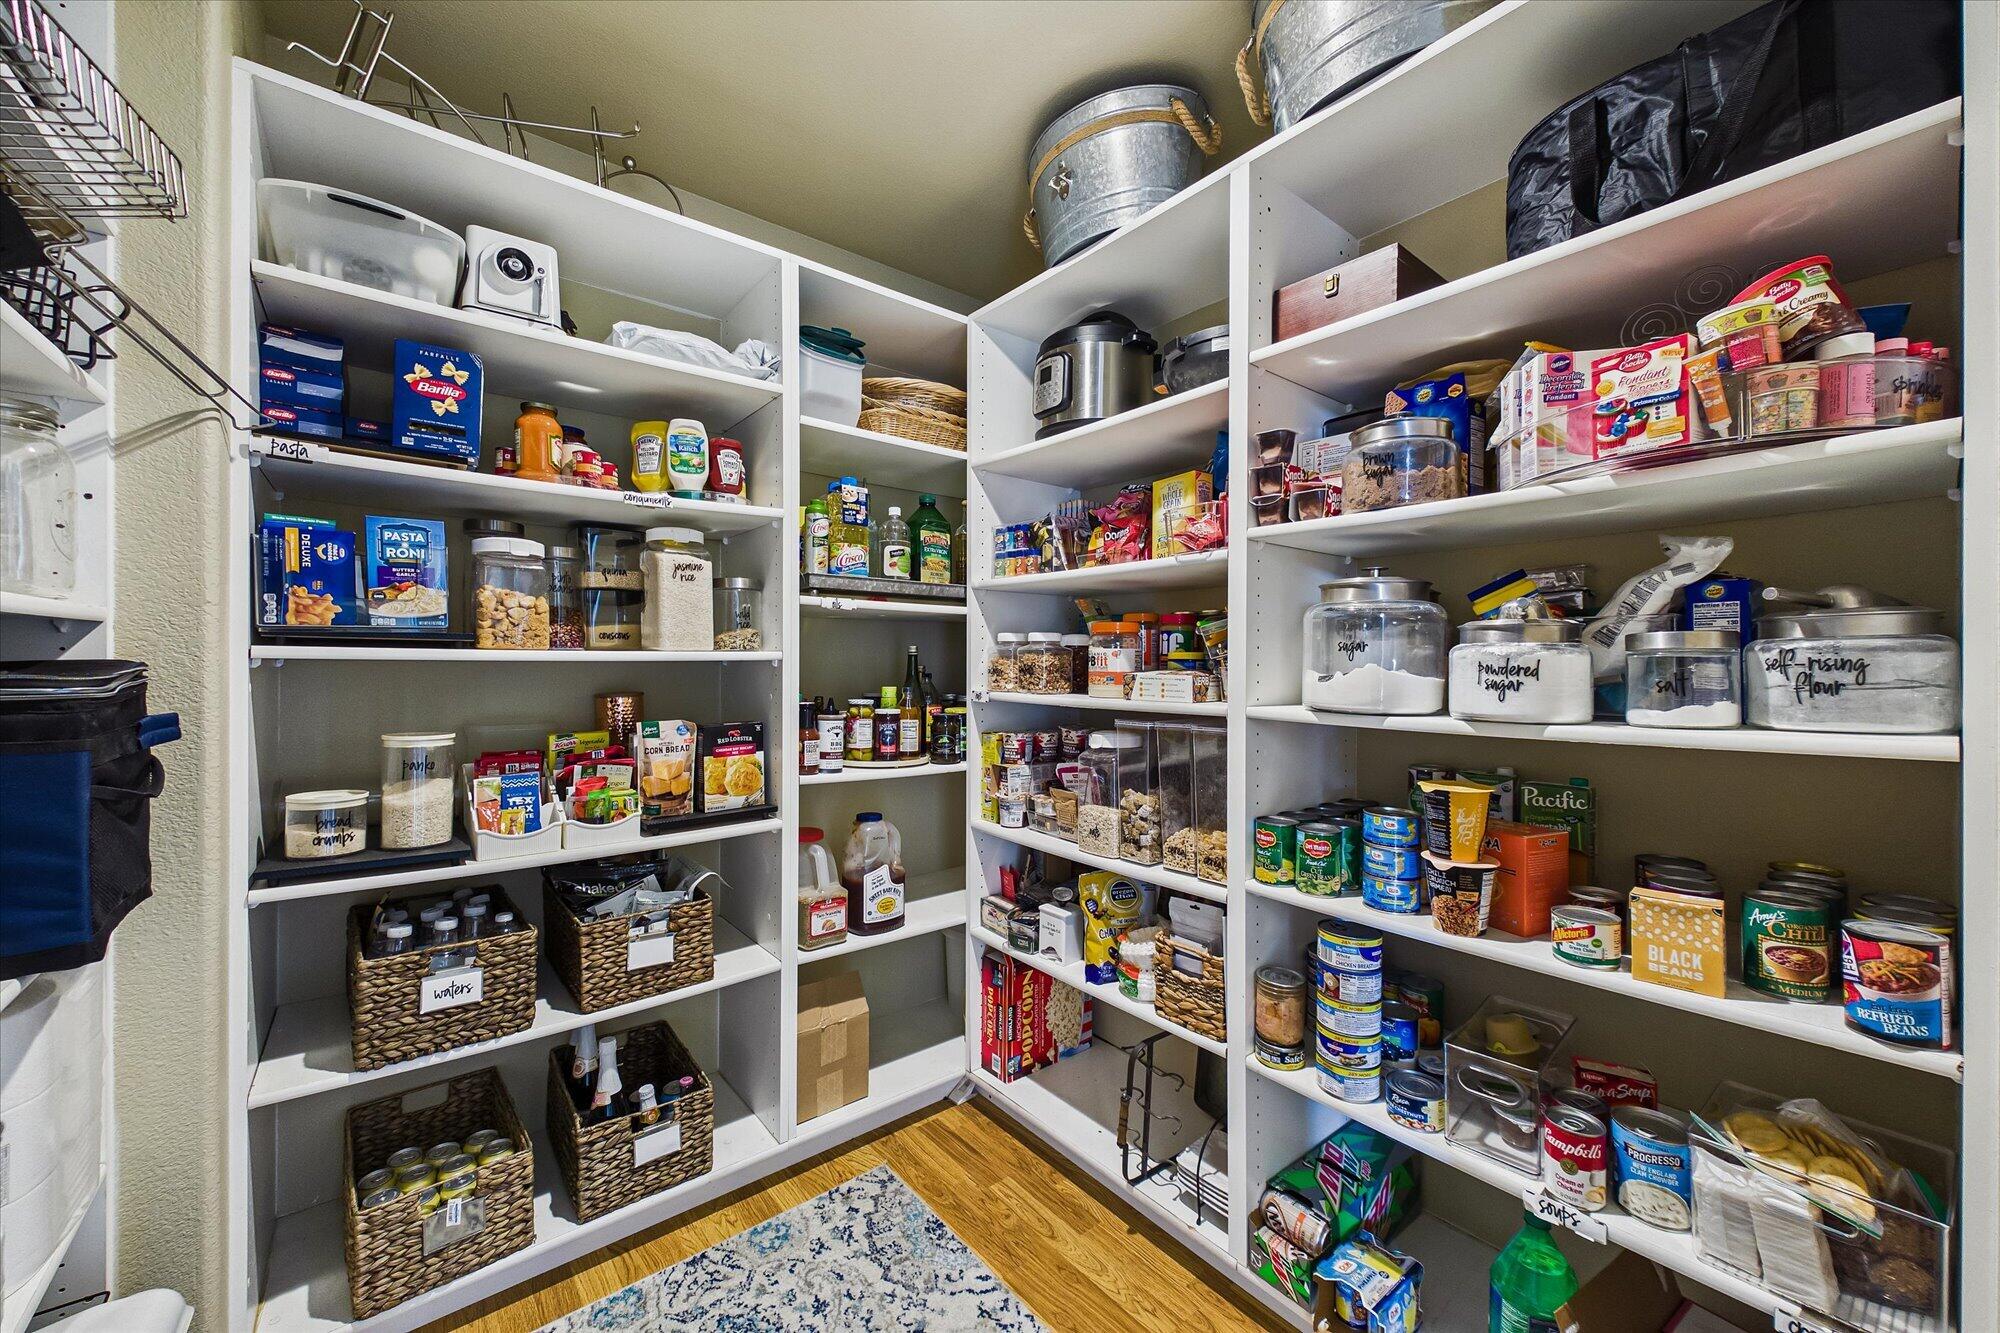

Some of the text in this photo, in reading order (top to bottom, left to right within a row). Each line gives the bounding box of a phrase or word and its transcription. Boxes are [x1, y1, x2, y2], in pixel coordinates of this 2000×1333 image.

[1768, 280, 1792, 296] Betty
[1789, 291, 1828, 310] Creamy
[420, 350, 460, 362] FARFALLE
[1625, 351, 1645, 363] Betty
[1660, 349, 1683, 358] NEW
[1619, 357, 1649, 370] Crocker
[1618, 367, 1669, 386] Fondant
[417, 381, 460, 398] Barilla
[1542, 380, 1585, 393] Preferred
[1545, 393, 1576, 402] Fondant
[268, 410, 294, 419] Barilla
[271, 438, 309, 459] pasta
[678, 444, 698, 453] Ranch
[1363, 451, 1395, 468] brown
[1364, 466, 1396, 487] sugar
[1163, 489, 1183, 500] WHOLE
[1163, 499, 1181, 509] GRAIN
[384, 531, 425, 543] PASTA
[302, 533, 312, 568] DELUXE
[386, 547, 425, 559] RONI
[839, 552, 863, 567] Crisco
[602, 567, 628, 582] quinoa
[672, 562, 704, 579] jasmine
[680, 572, 697, 583] rice
[598, 631, 631, 640] couscous
[1338, 640, 1369, 661] sugar
[1477, 659, 1541, 685] powdered
[1765, 650, 1870, 685] self-rising
[1484, 679, 1525, 702] sugar
[1656, 671, 1689, 697] salt
[1793, 672, 1847, 704] flour
[554, 740, 576, 749] Knorr
[580, 738, 605, 746] Vegetable
[645, 745, 690, 755] CORN BREAD
[402, 755, 436, 779] panko
[507, 796, 536, 805] TEX
[1521, 786, 1589, 810] Pacific
[315, 811, 352, 833] bread
[1264, 862, 1279, 870] CORN
[1301, 870, 1316, 879] GREEN
[869, 890, 882, 902] SWEET
[1748, 908, 1787, 926] Amy's
[1099, 928, 1117, 939] CHAI
[1557, 927, 1589, 940] Victoria
[1768, 922, 1826, 940] CHILI
[1336, 960, 1356, 968] CHICKEN
[1648, 945, 1703, 970] BLACK
[1648, 962, 1704, 981] BEANS
[433, 979, 474, 1000] waters
[1778, 985, 1824, 998] MEDIUM
[1022, 969, 1034, 1068] POPCORN
[1856, 1007, 1916, 1026] REFRIED
[1883, 1022, 1930, 1037] BEANS
[1008, 1059, 1014, 1075] 44
[1545, 1127, 1602, 1159] Campbell's
[1628, 1149, 1681, 1167] PROGRESSO
[1630, 1167, 1680, 1187] CLAM CHOWDER
[1632, 1161, 1677, 1180] NEW ENGLAND
[1556, 1173, 1576, 1187] Cream
[1557, 1181, 1583, 1196] Chicken
[1539, 1200, 1580, 1227] soups
